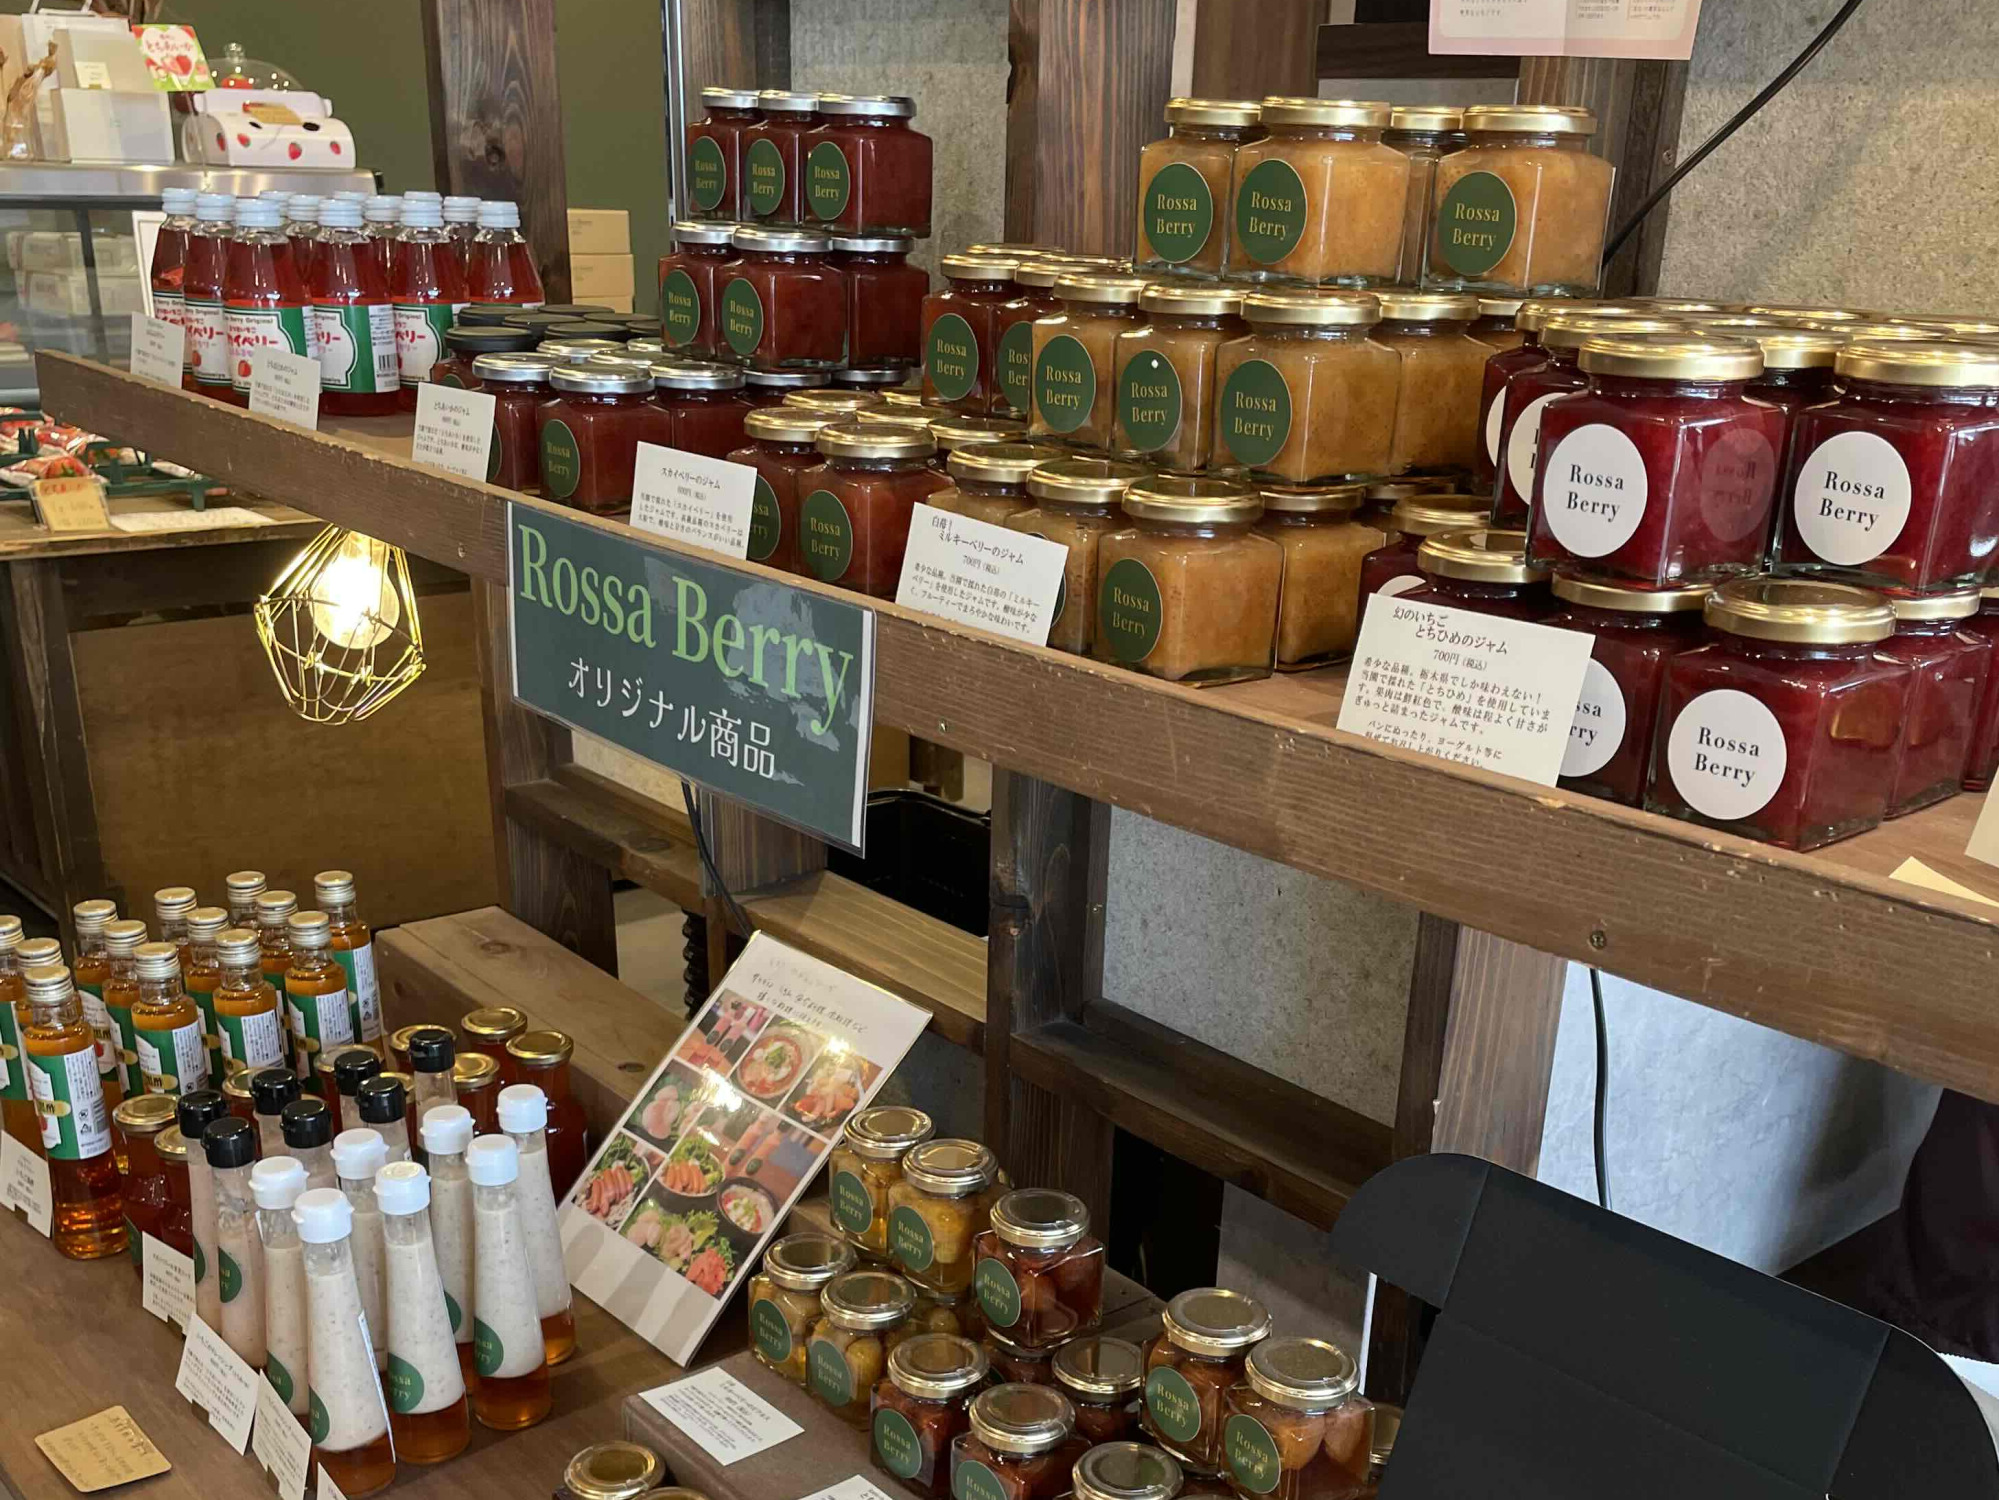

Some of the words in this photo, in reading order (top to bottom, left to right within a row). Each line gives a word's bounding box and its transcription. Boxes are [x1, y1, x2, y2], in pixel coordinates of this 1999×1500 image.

[752, 163, 776, 177] Rossa
[814, 166, 840, 179] Rossa
[753, 182, 775, 197] Berry
[815, 185, 840, 200] Berry
[1157, 194, 1197, 210] Rossa
[1251, 191, 1292, 212] Rossa
[1455, 203, 1500, 221] Rossa
[1156, 218, 1195, 237] Berry
[1249, 217, 1287, 240] Berry
[1453, 228, 1496, 250] Berry
[730, 300, 754, 318] Rossa
[730, 319, 752, 338] Berry
[227, 333, 278, 347] カイベリー
[937, 339, 967, 357] Rossa
[1008, 349, 1031, 365] Ros
[937, 360, 965, 380] Berry
[1008, 370, 1028, 386] Ber
[1046, 365, 1082, 384] Rossa
[1046, 389, 1080, 409] Berry
[1131, 382, 1168, 398] Rossa
[1235, 392, 1276, 412] Rossa
[1132, 408, 1167, 425] Berry
[1234, 417, 1274, 440] Berry
[661, 467, 721, 490] スカイベリーのジャム
[1569, 464, 1624, 490] Rossa
[1824, 471, 1885, 499] Rossa
[754, 504, 769, 517] ssa
[1566, 492, 1620, 522] Berry
[1819, 498, 1879, 531] Berry
[811, 517, 840, 536] Rossa
[811, 539, 840, 560] Berry
[939, 530, 1024, 565] ミルキーベリーのジャム
[1114, 587, 1149, 612] Rossa
[1113, 611, 1145, 638] Berry
[1392, 606, 1449, 628] 幻のいちご
[518, 524, 656, 649] Rossa
[672, 575, 853, 736] Berry
[1415, 625, 1508, 655] とちひめのジャム
[568, 657, 774, 779] オリジナル商品
[1576, 700, 1601, 718] ssa
[1569, 725, 1598, 746] rry
[1698, 727, 1760, 757] Rossa
[1694, 753, 1755, 788] Berry
[839, 1185, 864, 1206] Rossa
[840, 1199, 862, 1221] Berry
[898, 1221, 924, 1243] Rossa
[898, 1237, 922, 1259] Berry
[984, 1273, 1010, 1299] Rossa
[984, 1289, 1009, 1314] Berry
[1157, 1383, 1189, 1411] Rossa
[1156, 1400, 1187, 1427] Berry
[884, 1424, 911, 1450] Rossa
[1236, 1431, 1268, 1463] Rossa
[884, 1439, 909, 1464] Berry
[1234, 1448, 1264, 1479] Berry
